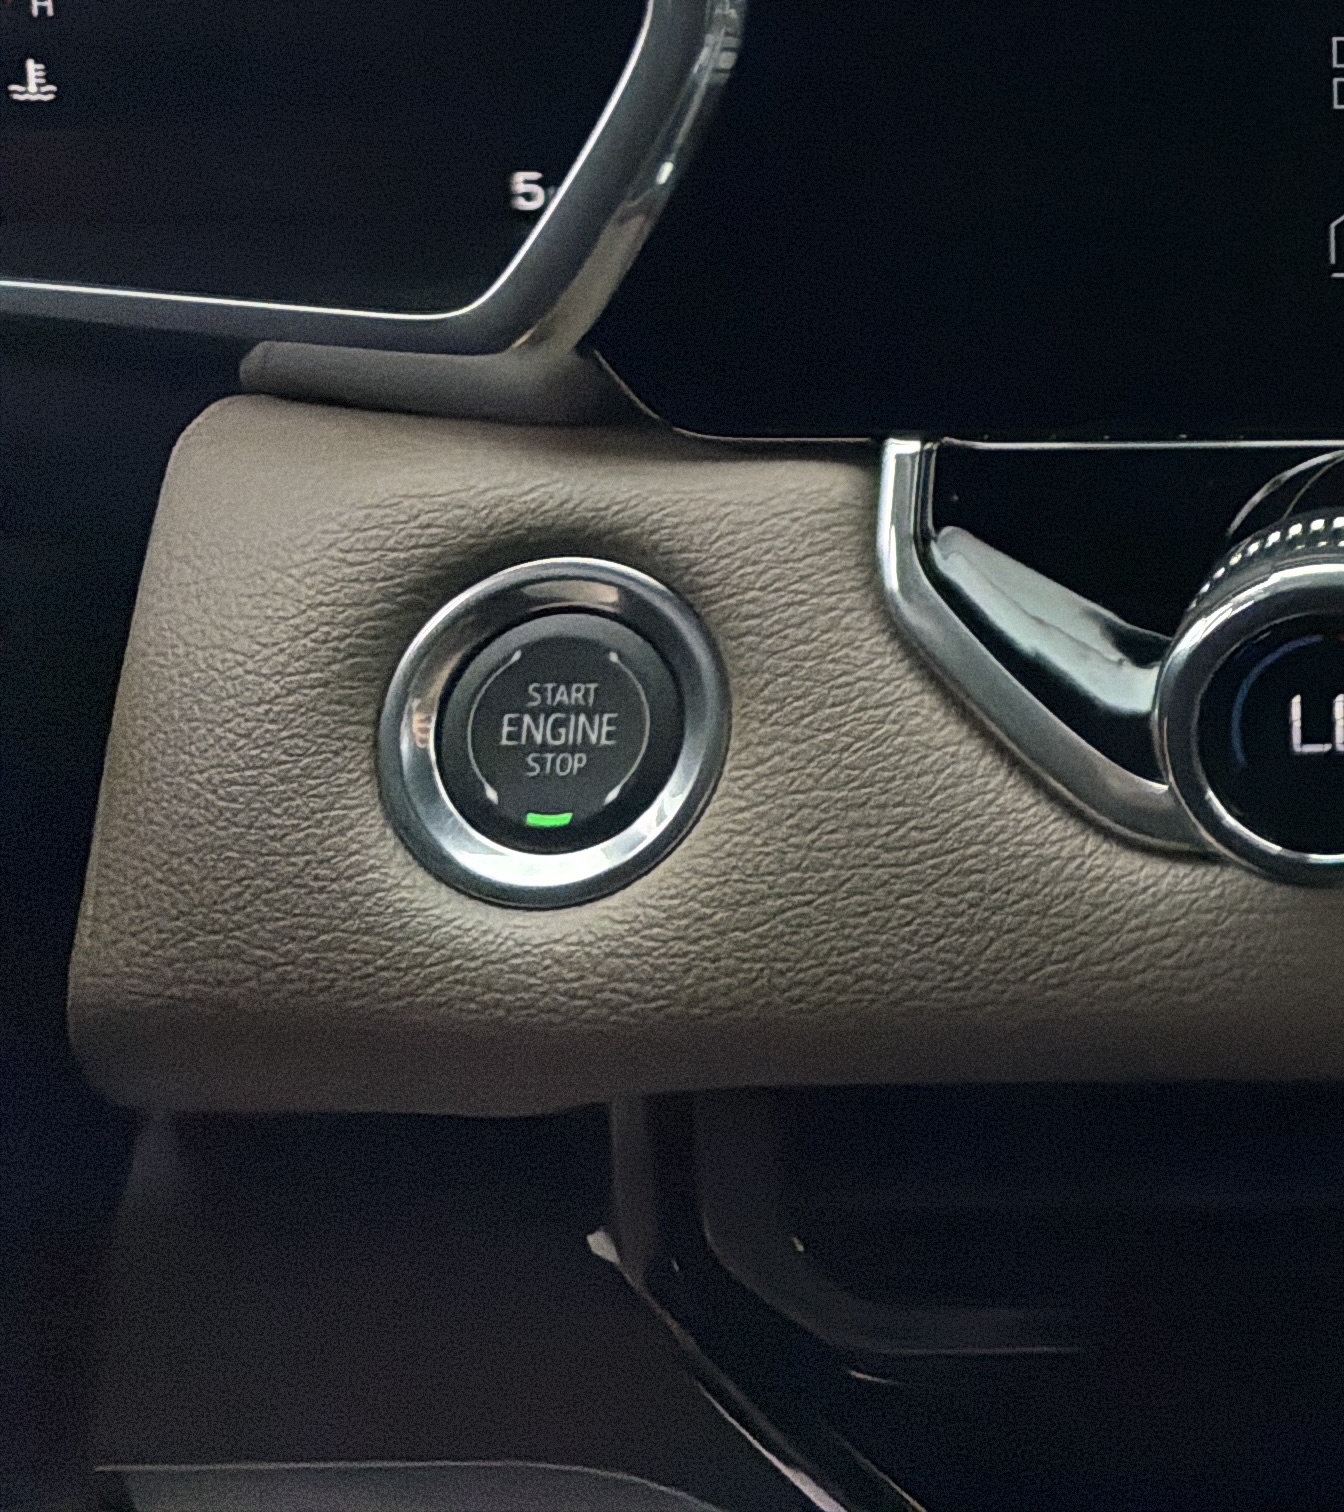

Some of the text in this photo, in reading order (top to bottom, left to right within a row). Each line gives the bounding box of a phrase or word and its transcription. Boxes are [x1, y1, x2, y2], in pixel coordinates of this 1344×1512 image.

[526, 681, 600, 707] START
[499, 713, 620, 747] ENGINE
[525, 752, 587, 778] STOP
